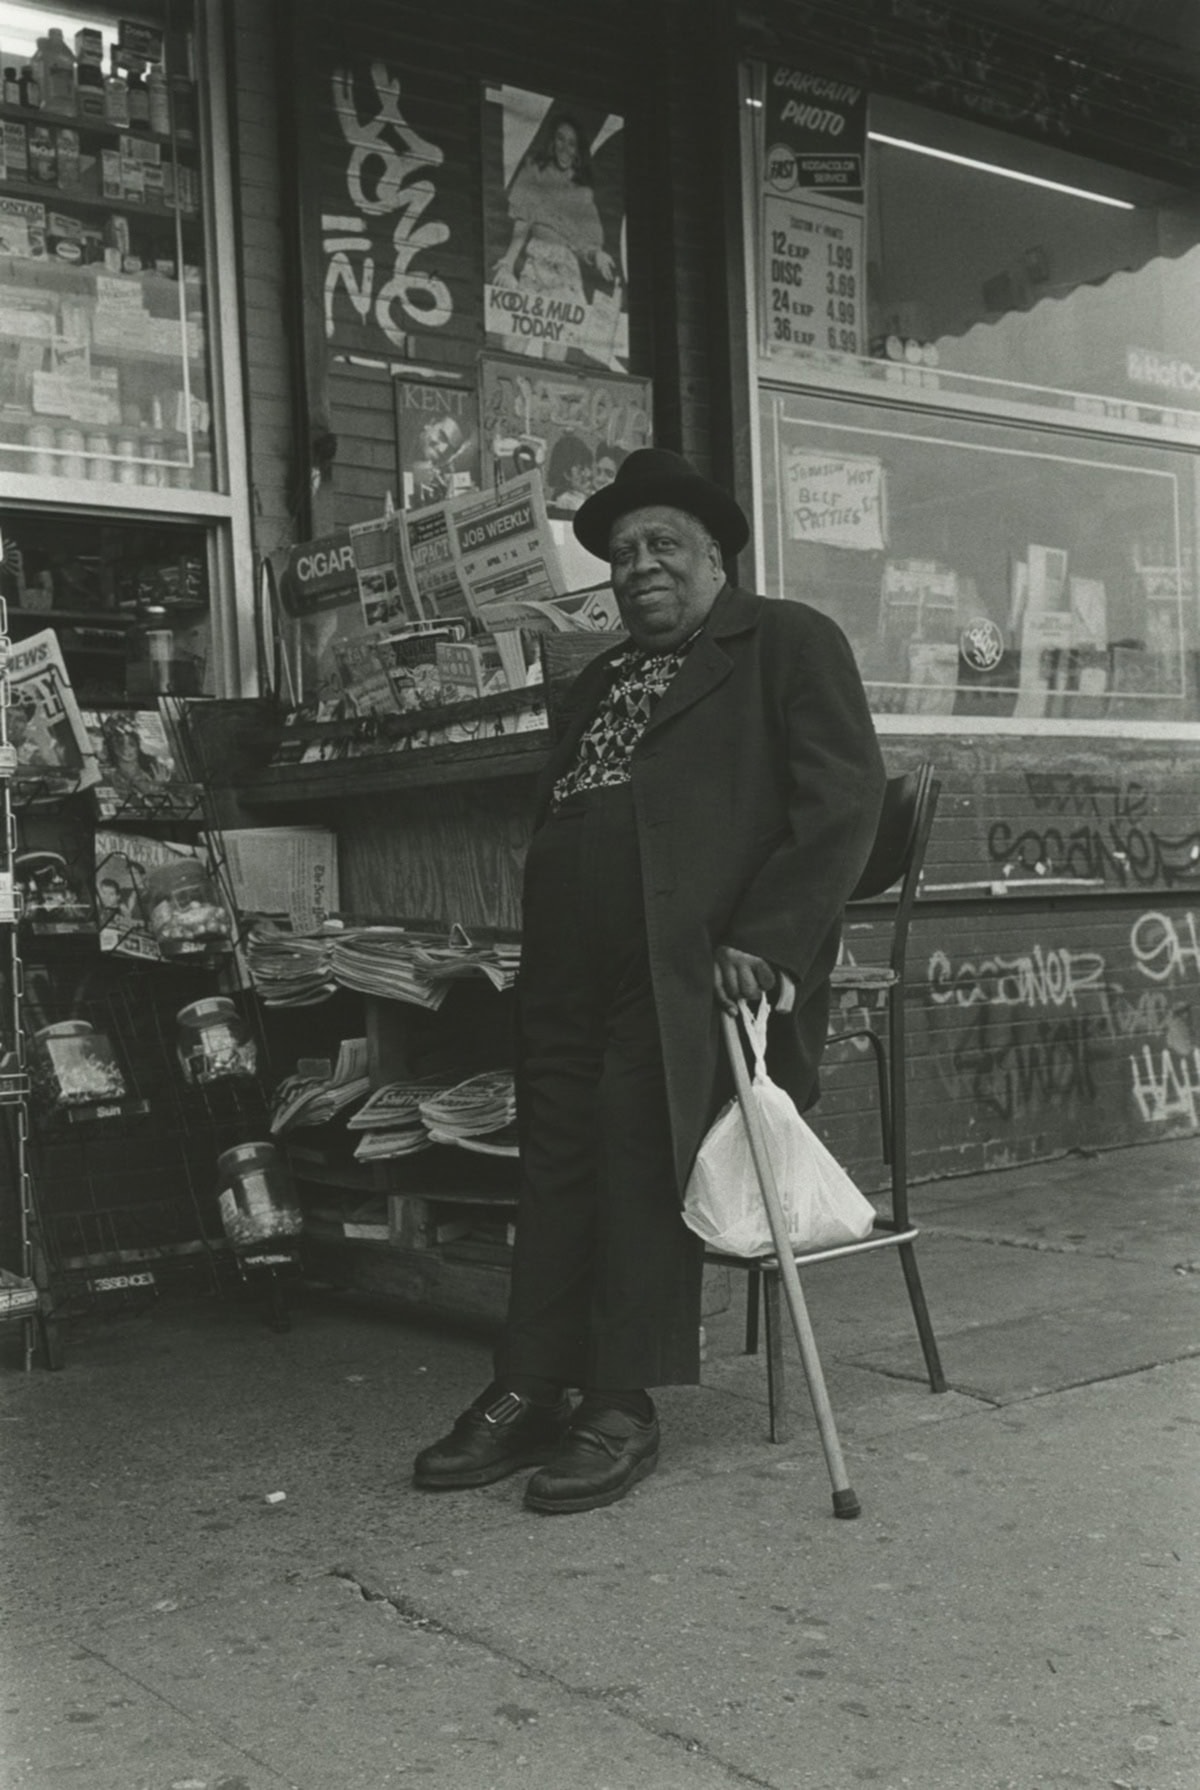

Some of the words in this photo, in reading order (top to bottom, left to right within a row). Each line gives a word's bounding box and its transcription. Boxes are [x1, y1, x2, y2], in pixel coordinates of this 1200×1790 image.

[780, 99, 846, 136] PHOTO
[772, 230, 786, 255] 12
[788, 244, 810, 259] EXP
[828, 243, 852, 270] 1.99
[771, 259, 802, 287] DISC
[489, 288, 529, 315] KOOL
[531, 297, 544, 317] &
[546, 300, 585, 325] MILD
[772, 288, 789, 312] 24
[792, 302, 814, 316] EXP
[511, 314, 564, 341] TODAY
[774, 317, 791, 341] 36
[794, 331, 815, 346] EXP
[403, 384, 468, 415] KENT
[462, 526, 486, 548] JOB
[486, 507, 531, 538] WEEKLY
